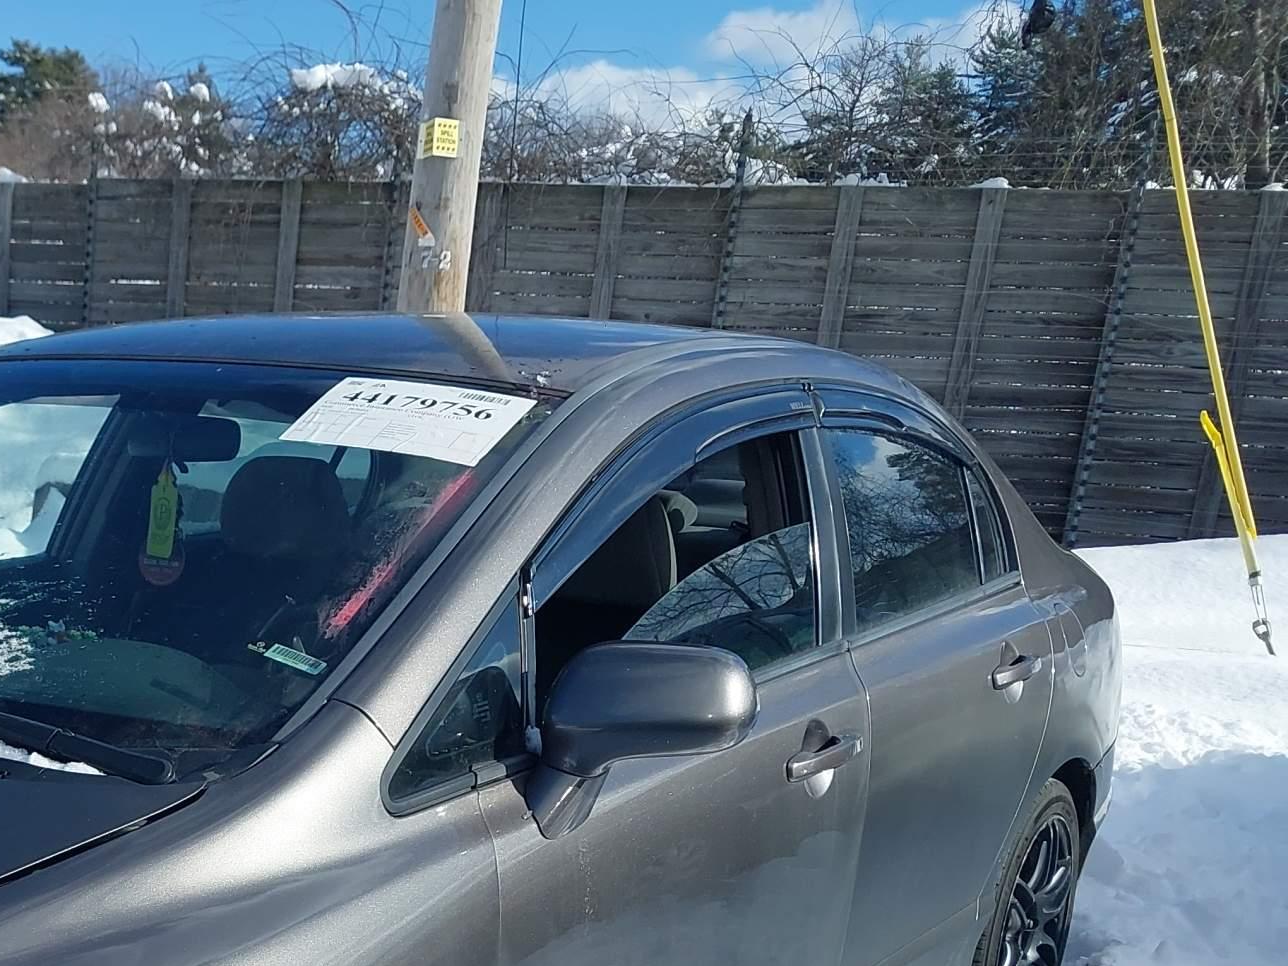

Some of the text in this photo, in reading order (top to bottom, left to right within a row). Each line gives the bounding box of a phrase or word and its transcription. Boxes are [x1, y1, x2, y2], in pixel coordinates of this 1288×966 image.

[440, 130, 454, 138] SPILL
[436, 137, 456, 145] STATION
[342, 390, 496, 421] 44179756
